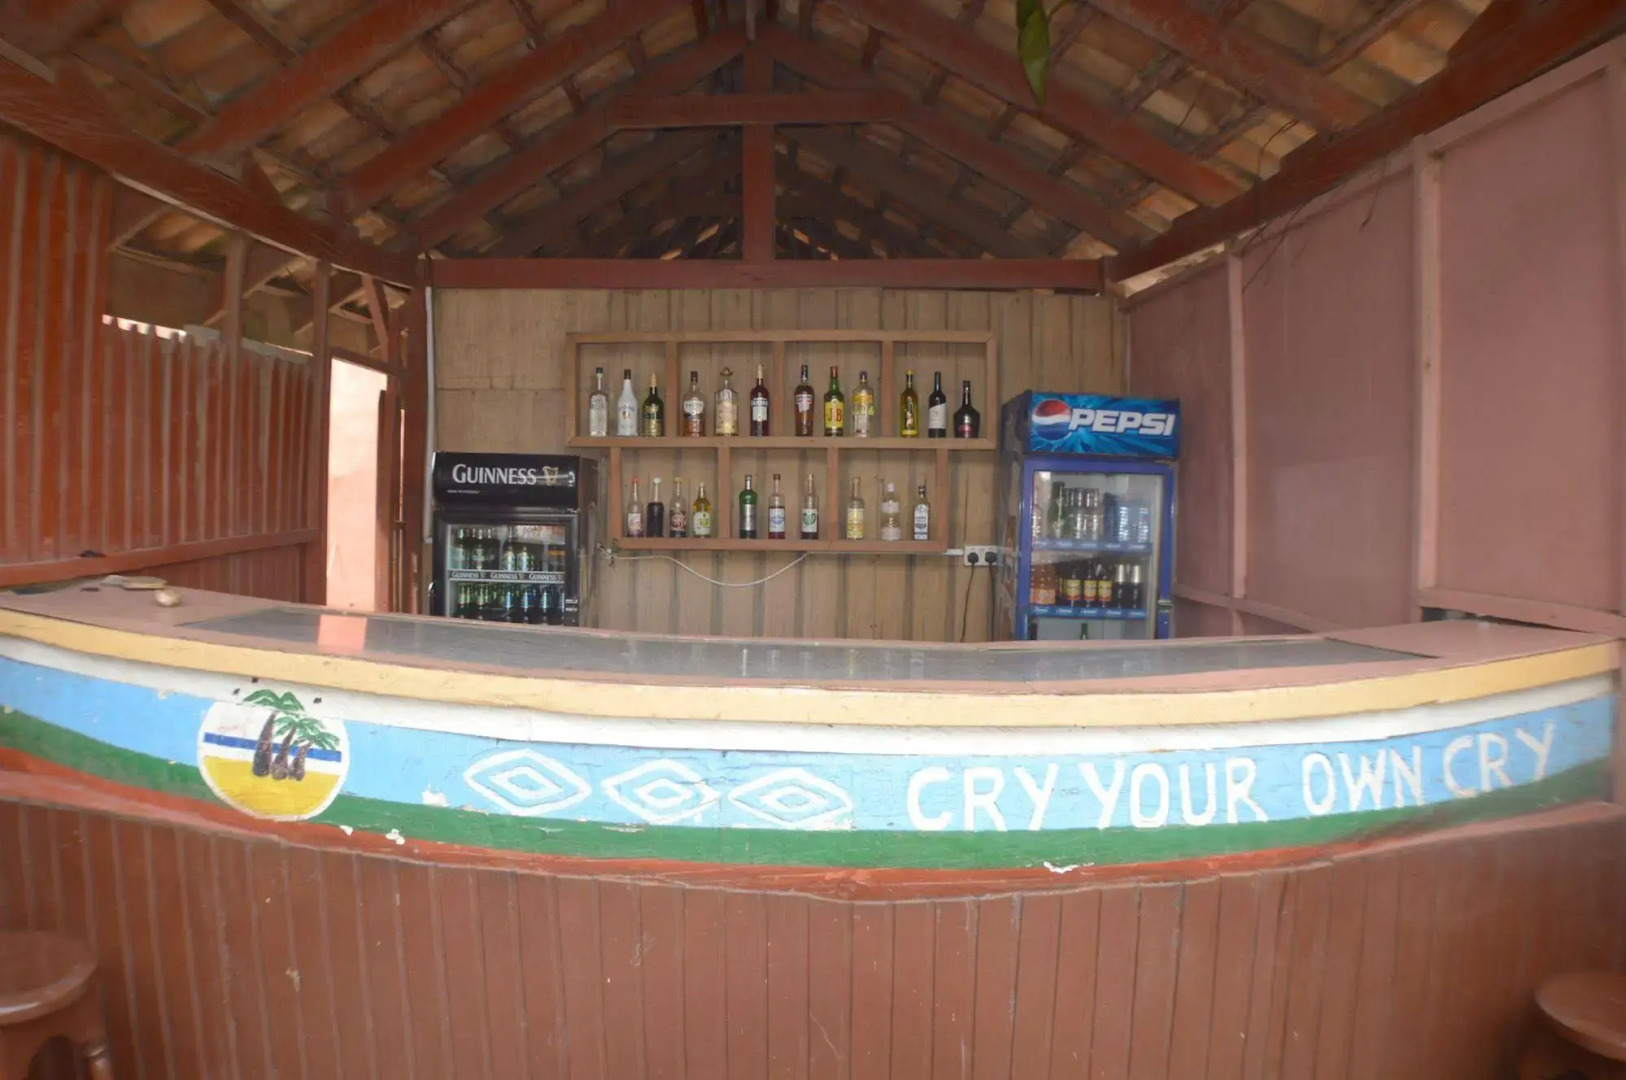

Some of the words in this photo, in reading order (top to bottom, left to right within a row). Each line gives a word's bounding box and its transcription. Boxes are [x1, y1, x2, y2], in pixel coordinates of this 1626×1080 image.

[1068, 408, 1176, 436] PEPSI
[452, 464, 537, 485] GUINNESS
[452, 571, 479, 579] GUINNESS
[907, 763, 1059, 831] CRY
[1079, 756, 1269, 829] YOUR
[1302, 745, 1423, 816] OWN
[1443, 718, 1557, 798] CRY
